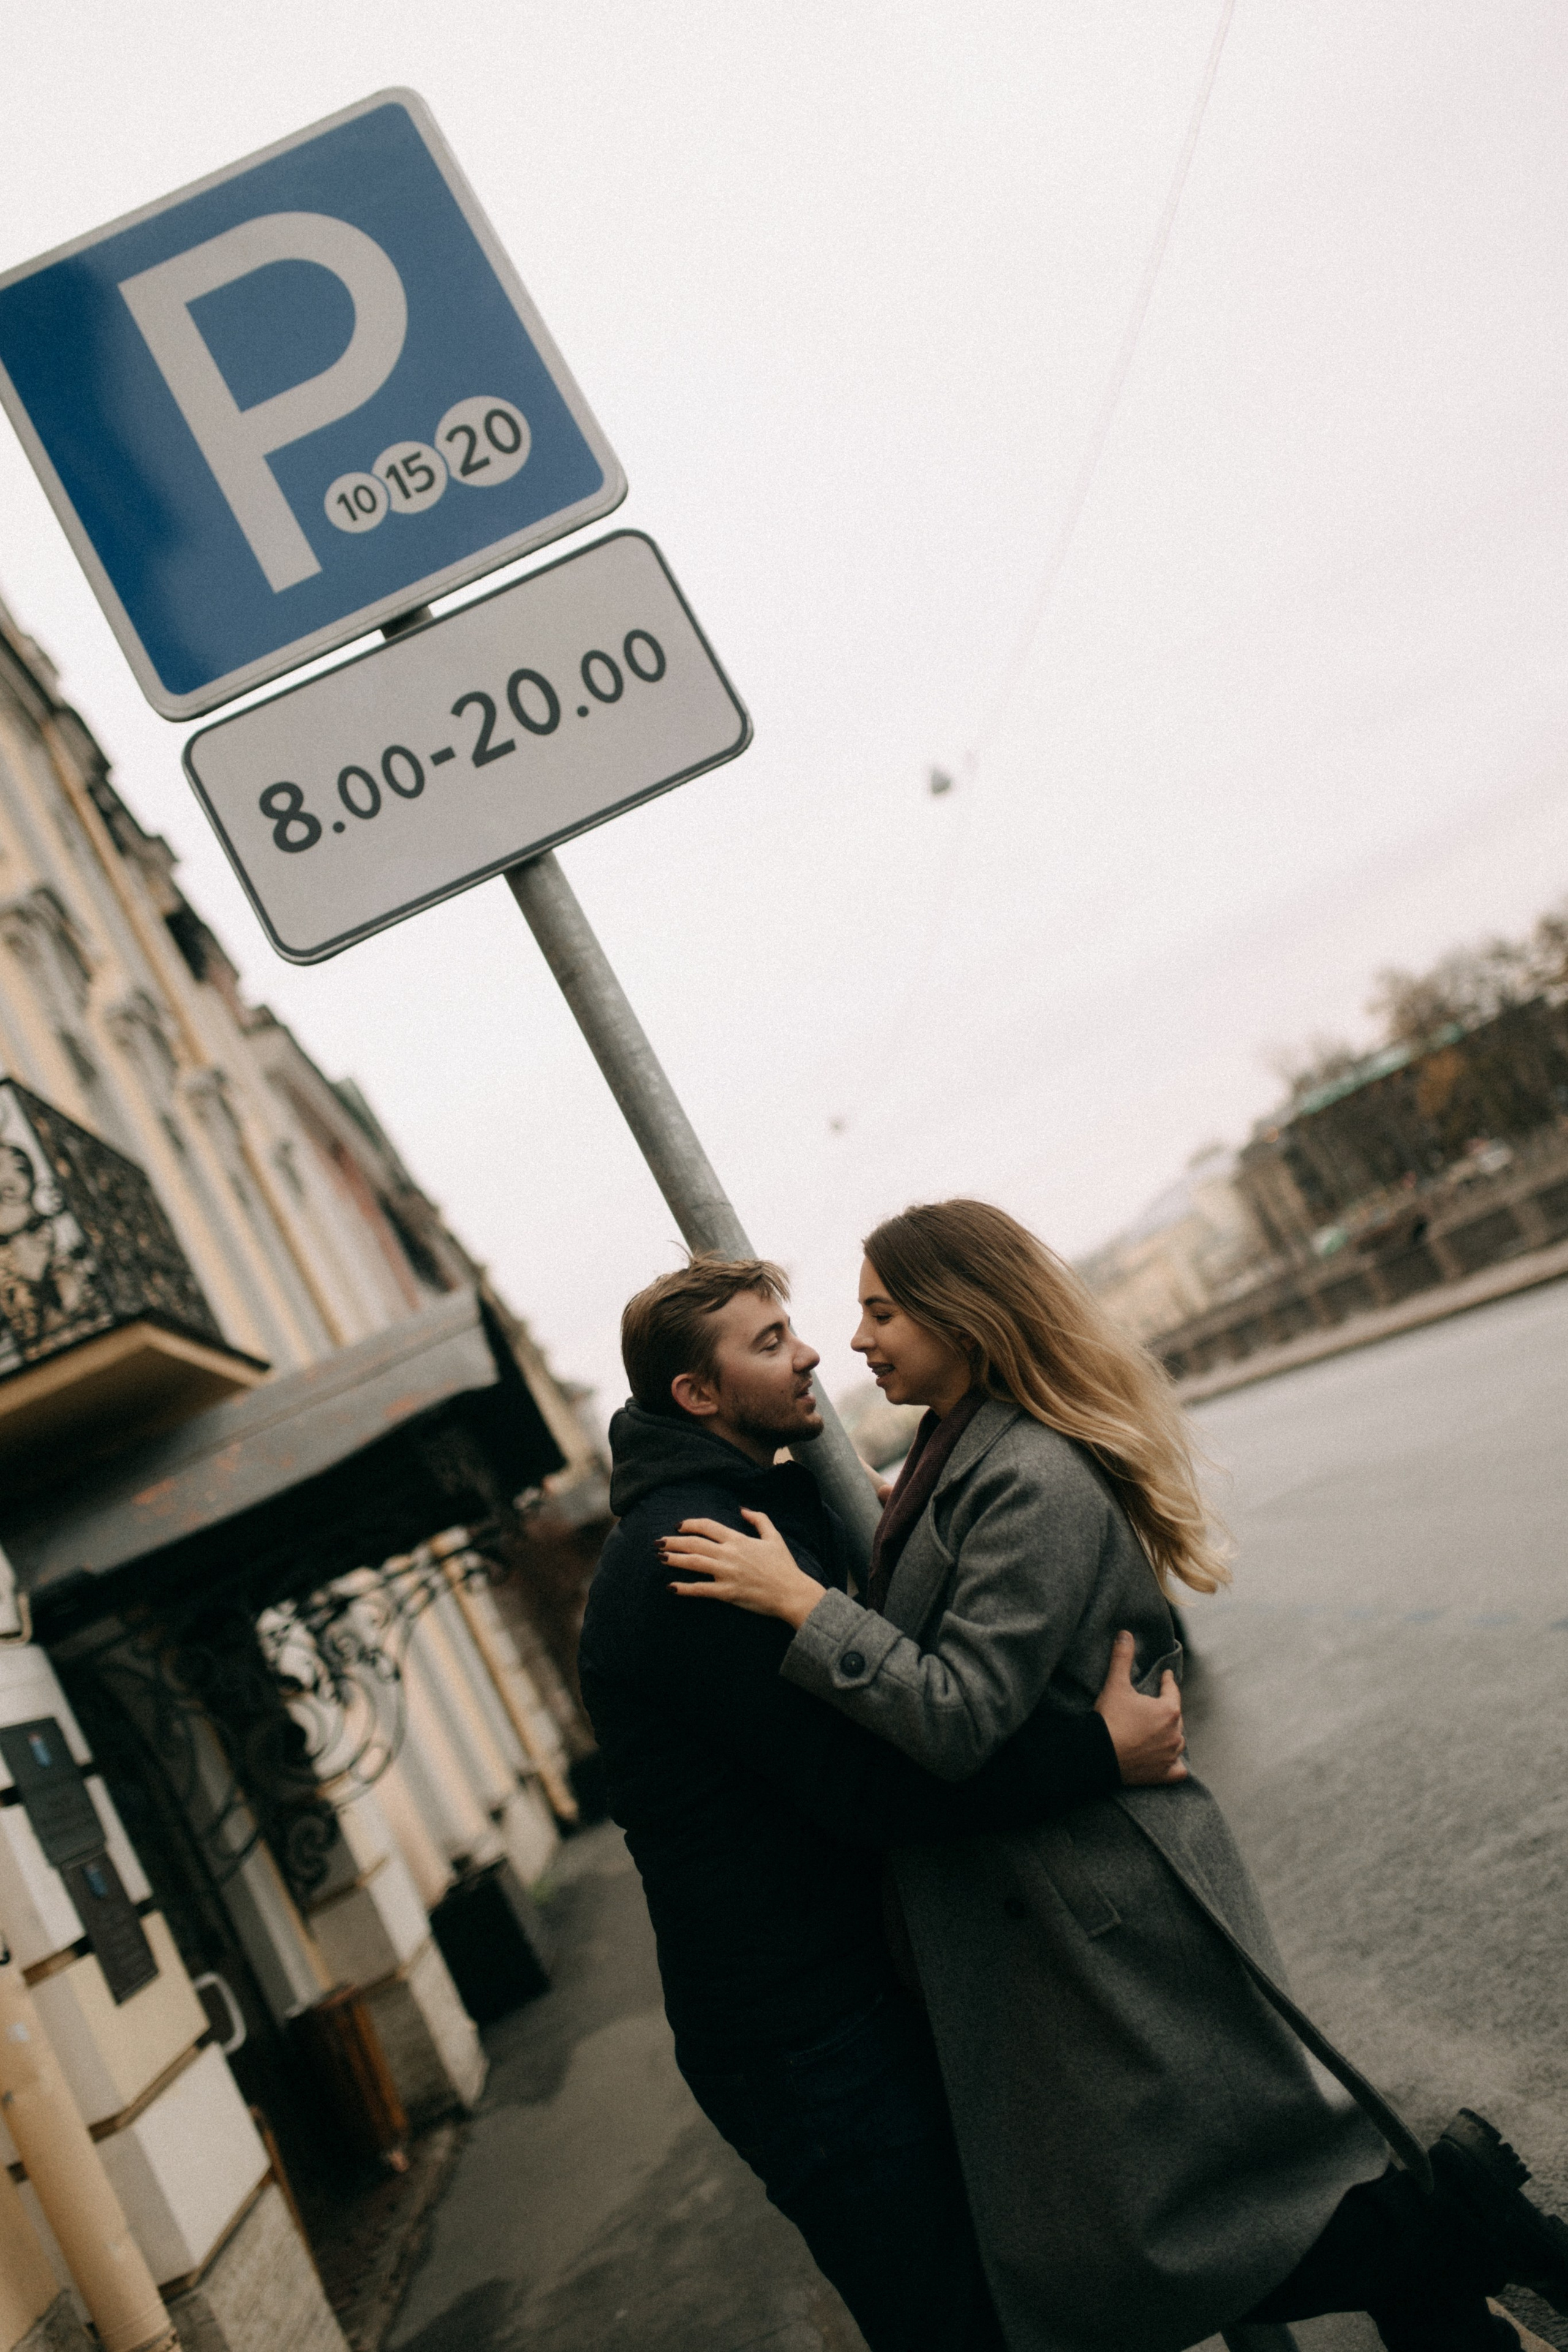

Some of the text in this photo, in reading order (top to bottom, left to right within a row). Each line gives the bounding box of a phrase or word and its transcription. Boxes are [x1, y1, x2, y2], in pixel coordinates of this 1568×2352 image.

[118, 211, 408, 594] P
[336, 409, 522, 522] 10 15 20
[258, 628, 667, 854] 8.00-20.00
